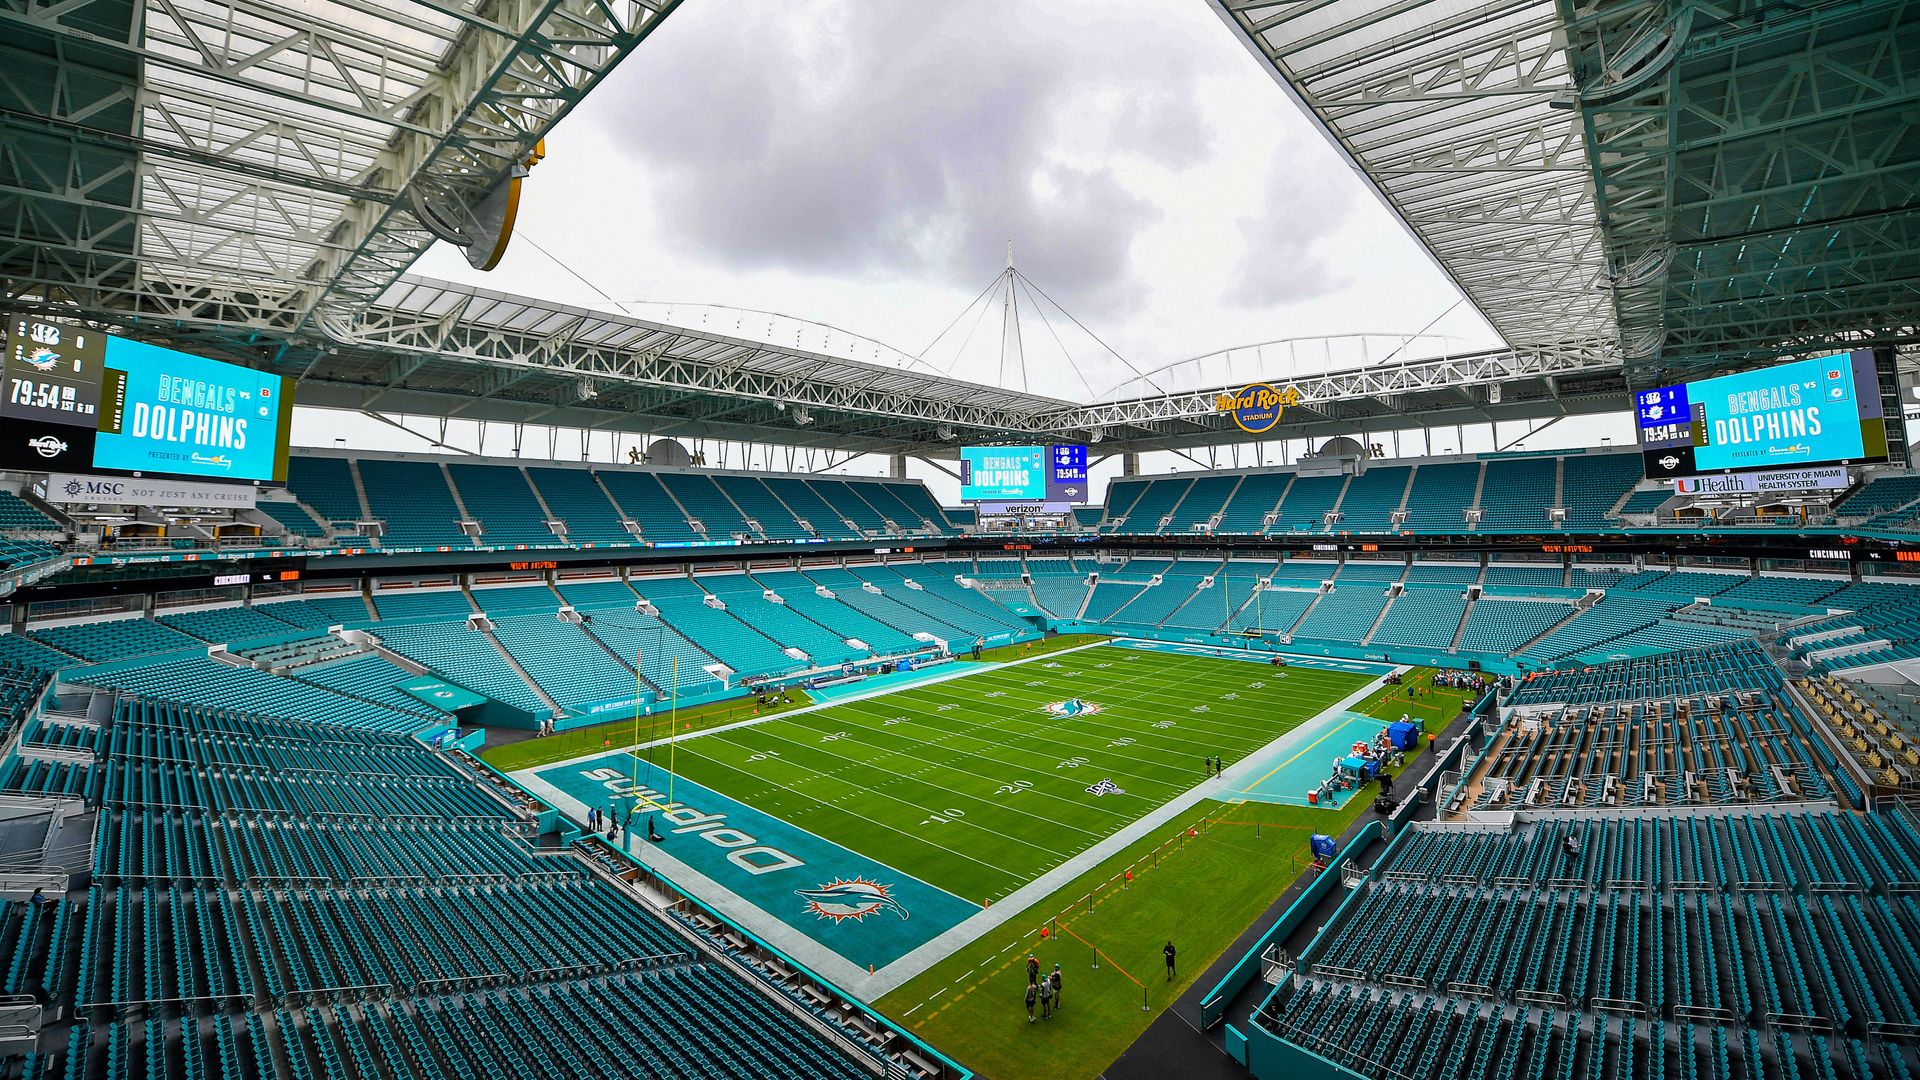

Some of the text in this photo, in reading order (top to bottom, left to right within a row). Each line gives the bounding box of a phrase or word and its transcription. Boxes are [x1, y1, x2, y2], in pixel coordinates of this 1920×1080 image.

[10, 378, 60, 410] 79:54
[158, 374, 236, 413] BENGALS
[1216, 386, 1299, 411] Hard Rock
[1728, 383, 1801, 415] BENGALS
[1242, 413, 1273, 421] STADIUM
[132, 402, 247, 450] DOLPHINS
[1715, 406, 1821, 445] DOLPHINS
[1643, 425, 1669, 442] 79:54
[1732, 449, 1758, 458] PRESENTED
[983, 456, 1021, 470] BENGALS
[974, 469, 1030, 487] DOLPHINS
[1757, 469, 1841, 481] UNIVERSITY OF MIAMI
[85, 481, 124, 495] MSC
[1758, 479, 1818, 490] HEALTH SYSTEM
[132, 489, 249, 501] NOT JUST ANY CRUISE
[1005, 504, 1041, 513] verizon
[1809, 549, 1851, 559] CINCINNATI
[1000, 780, 1034, 794] 20
[579, 767, 806, 876] Dolphins
[929, 808, 965, 824] 10
